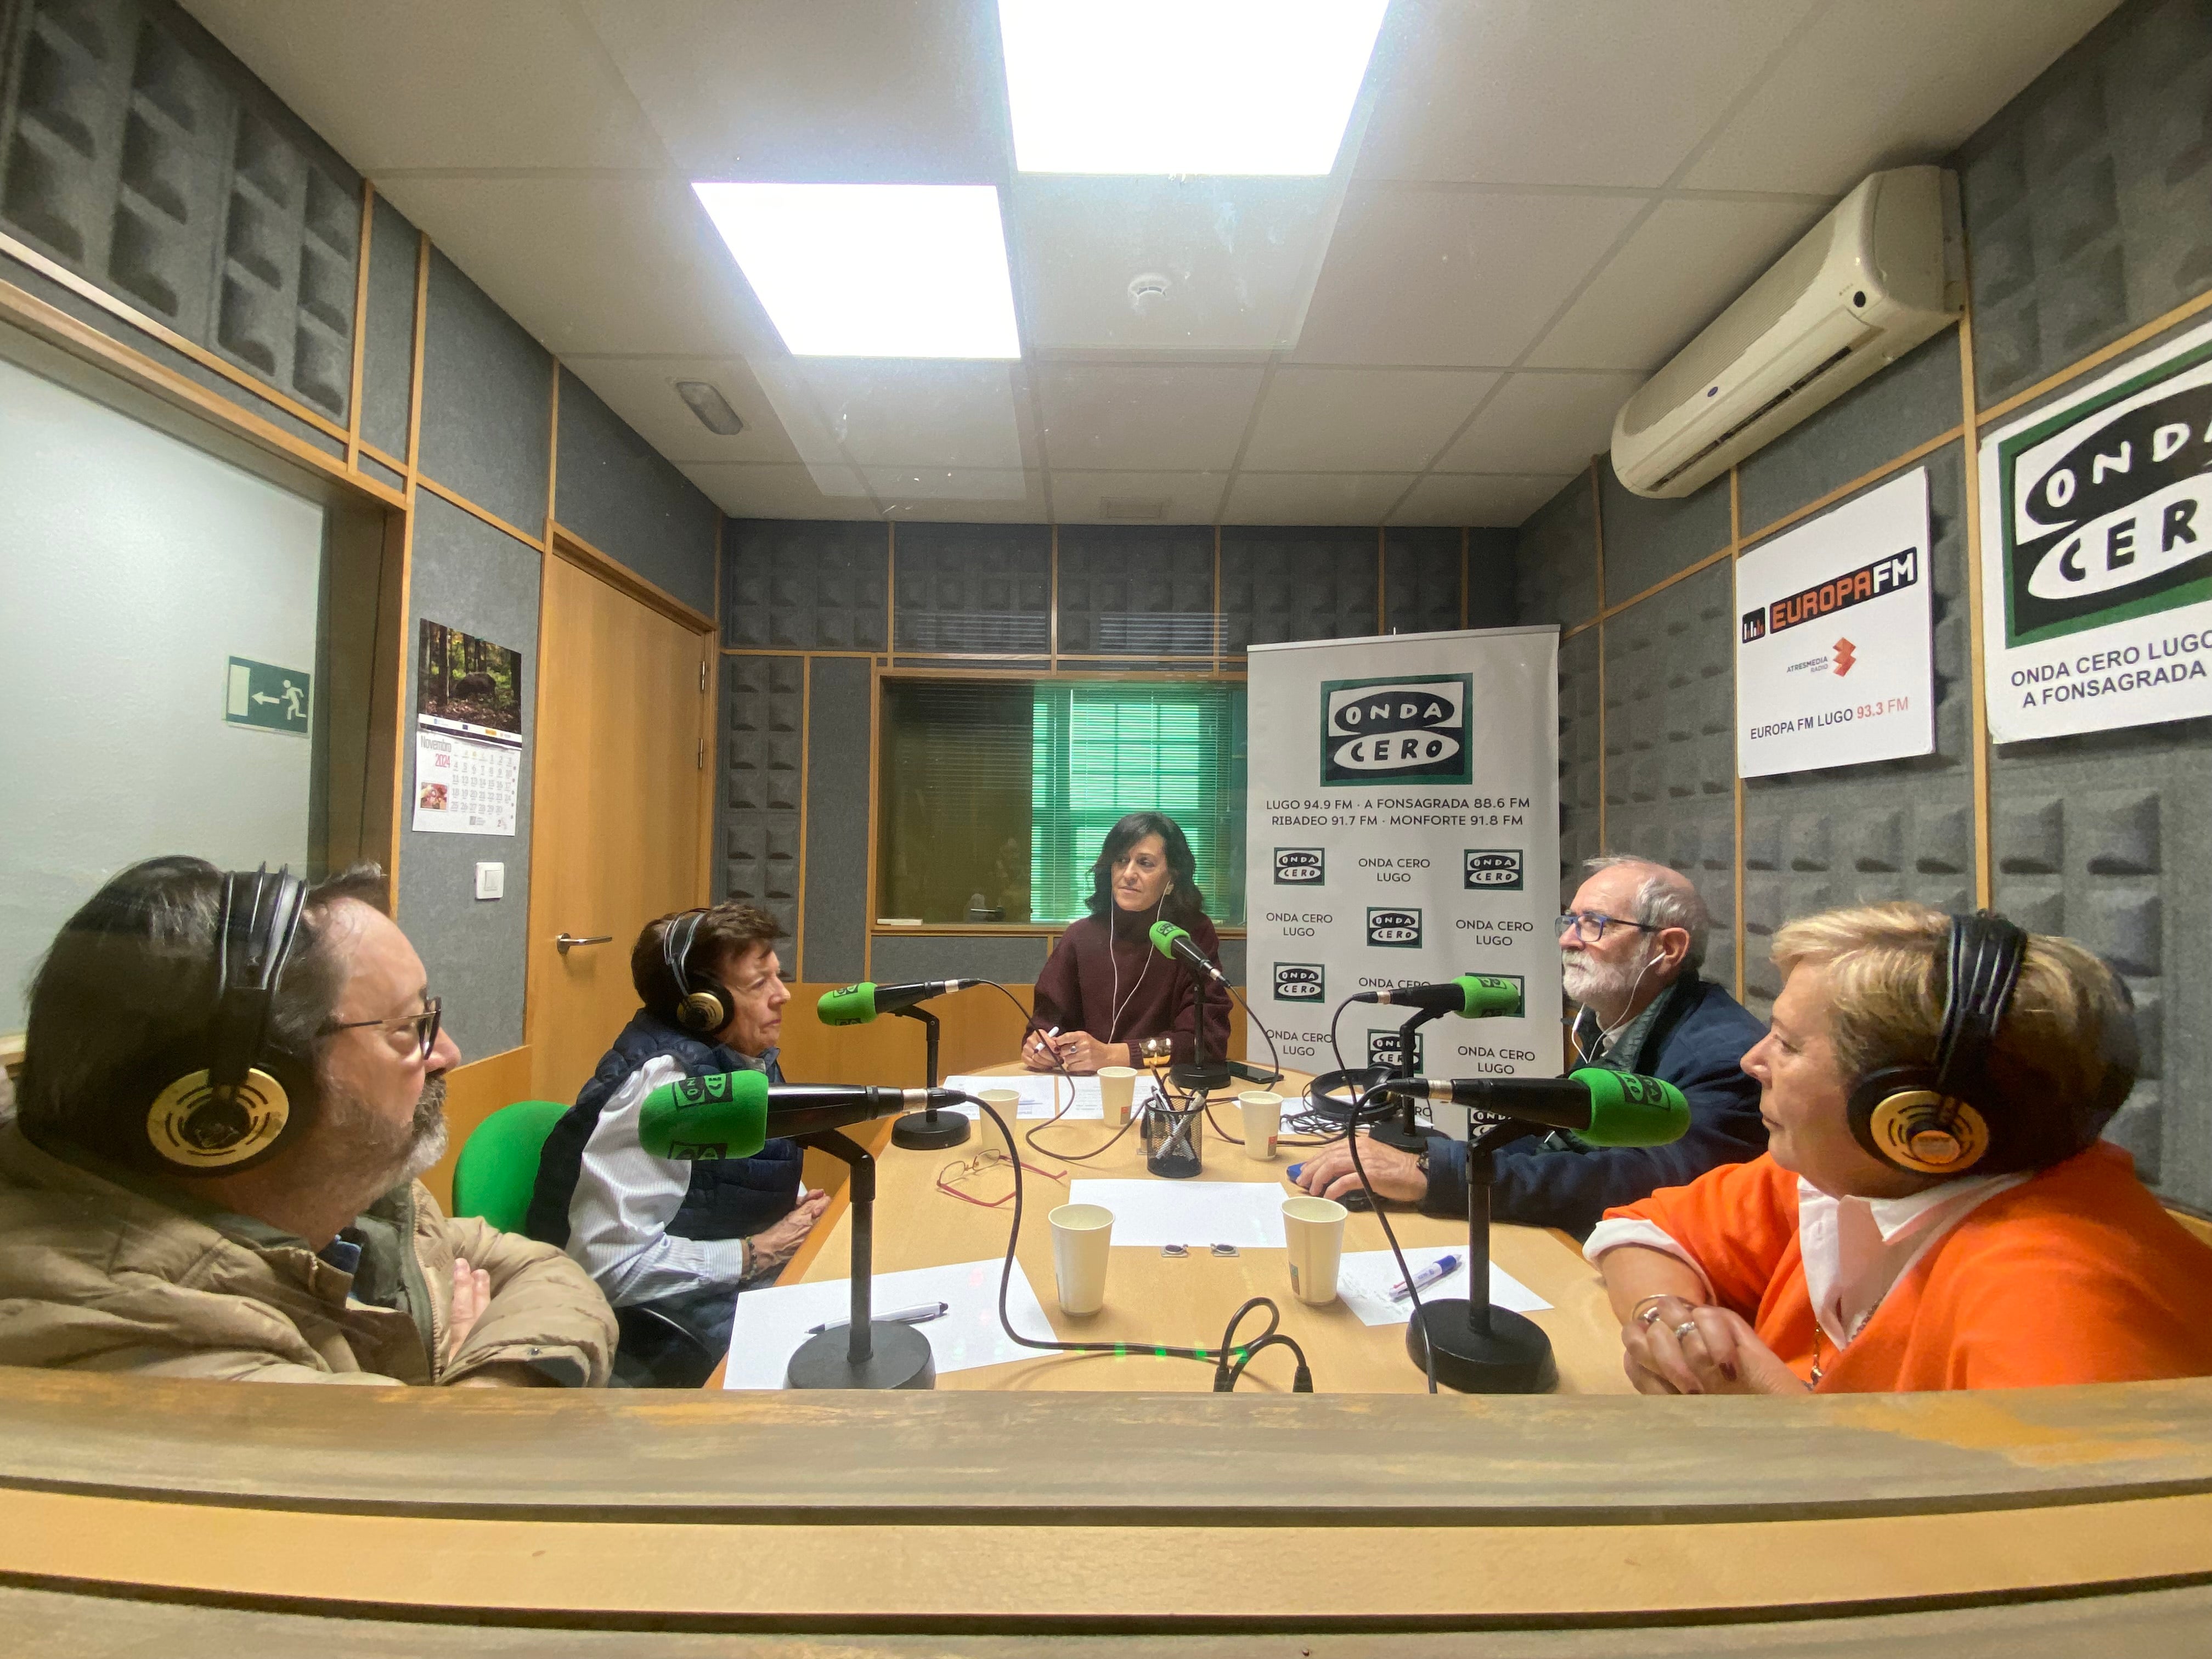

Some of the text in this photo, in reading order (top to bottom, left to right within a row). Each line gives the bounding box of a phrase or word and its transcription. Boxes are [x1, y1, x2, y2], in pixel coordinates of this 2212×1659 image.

[2046, 419, 2212, 507] OND
[2059, 499, 2198, 582] CER
[2011, 629, 2212, 687] ONDA CERO LUGO
[1786, 656, 1828, 673] ATRESMEDIA
[1810, 663, 1829, 674] RADIO
[2023, 660, 2207, 708] A FONSAGRADA
[1346, 702, 1442, 725] ONDA
[1750, 696, 1909, 740] EUROPA FM LUGO 93.3 FM
[421, 735, 452, 753] Novembro
[1350, 739, 1442, 761] CERO
[435, 753, 450, 769] 2024
[1266, 800, 1300, 809] LUGO
[1304, 800, 1330, 809] 94.9
[1335, 799, 1352, 809] FM
[1364, 799, 1373, 808] A
[1377, 799, 1469, 808] FONSAGRADA
[1474, 798, 1505, 808] 88.6
[1510, 798, 1530, 808] FM
[1272, 816, 1327, 825] RIBADEO
[1331, 816, 1356, 825] 91.7
[1360, 816, 1377, 825] FM
[1390, 815, 1466, 825] MONFORTE
[1470, 815, 1498, 826] 91.8
[1503, 815, 1522, 825] FM
[1358, 858, 1430, 868] ONDA CERO
[1474, 859, 1512, 867] ONDA
[1376, 873, 1411, 882] LUGO
[1476, 873, 1512, 881] CERO
[1266, 912, 1333, 923] ONDA CERO
[1283, 927, 1315, 936] LUGO
[1455, 919, 1533, 932] ONDA CERO
[1476, 935, 1513, 946] LUGO
[1358, 977, 1393, 988] ONDA
[1266, 1029, 1333, 1043] ONDA CERO
[1283, 1045, 1315, 1056] LUGO
[1458, 1046, 1535, 1061] ONDA CERO
[1478, 1062, 1514, 1074] LUGO
